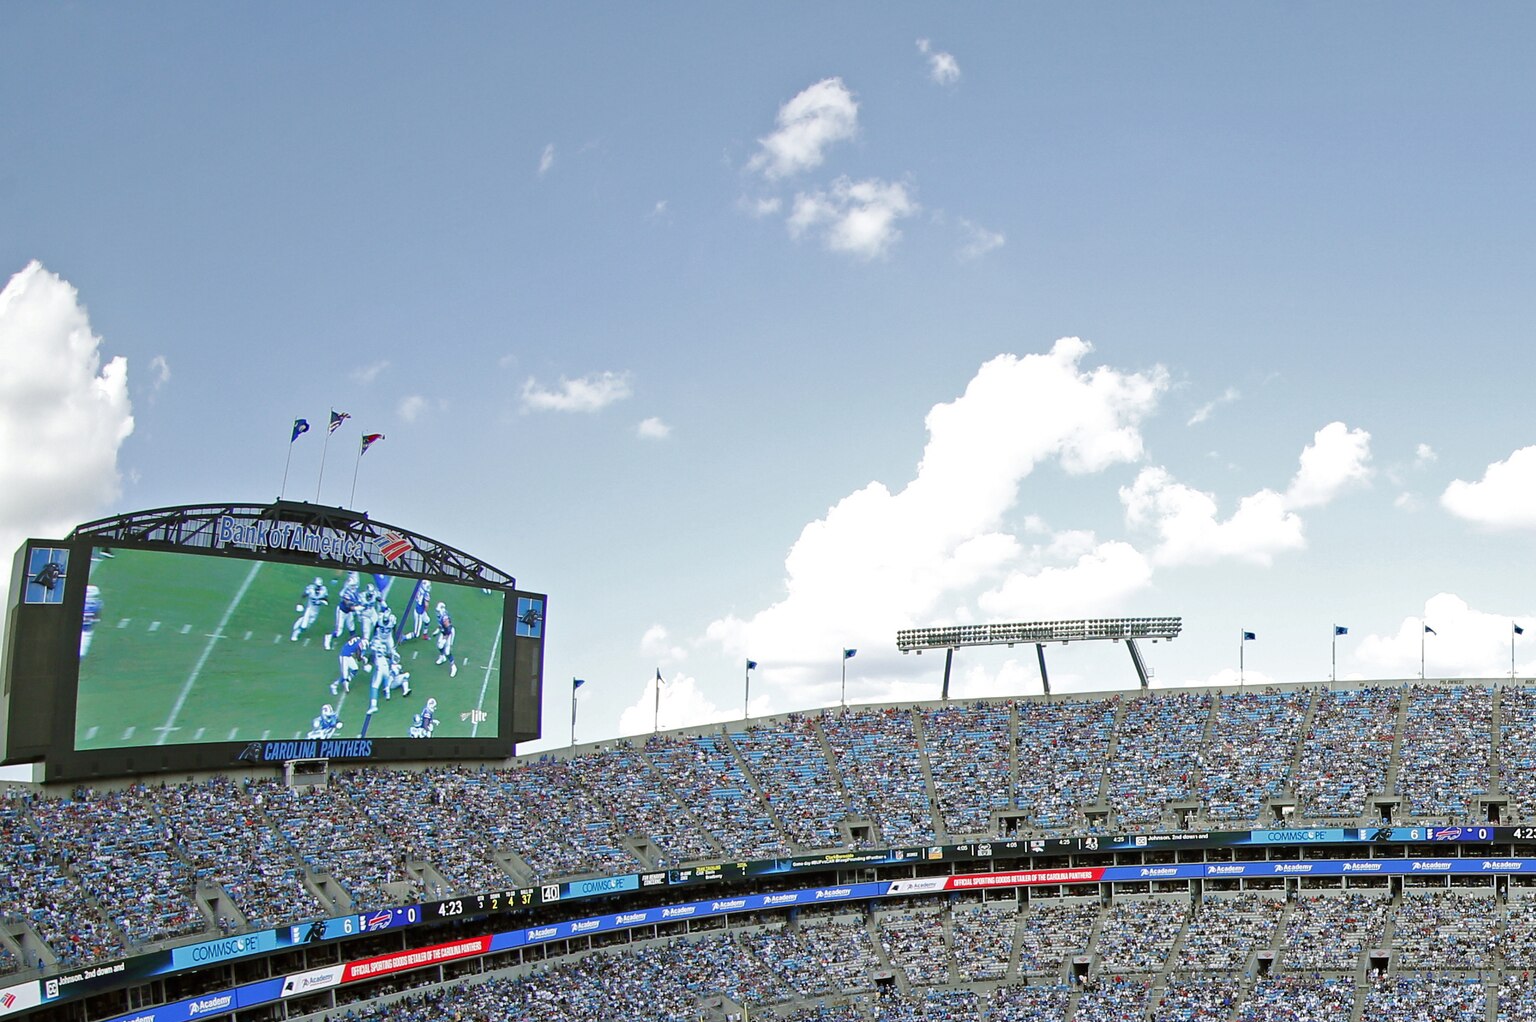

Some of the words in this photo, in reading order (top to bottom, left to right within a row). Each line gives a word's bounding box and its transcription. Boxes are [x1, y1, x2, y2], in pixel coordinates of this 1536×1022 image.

[219, 516, 267, 547] Bank
[269, 525, 291, 549] of
[291, 526, 364, 559] America
[471, 709, 487, 725] Lite
[264, 741, 317, 761] CAROLINA
[320, 740, 373, 759] PANTHERS
[1268, 831, 1325, 841] COMMSCOPE
[1410, 829, 1418, 839] 6
[1478, 828, 1486, 839] 0
[1217, 865, 1245, 873] Academy
[1284, 864, 1312, 872] Academy
[1422, 862, 1451, 870] Academy
[1492, 862, 1522, 870] Academy
[954, 878, 972, 886] OFFICIAL
[973, 876, 995, 886] SPORTING
[1012, 874, 1032, 883] RETAILER
[1047, 872, 1068, 880] CAROLINA
[1069, 871, 1092, 879] PANTHERS
[582, 878, 624, 893] COMMSCOPE
[544, 886, 558, 900] 40
[824, 888, 850, 897] Academy
[508, 896, 514, 906] 4
[522, 894, 532, 904] 37
[438, 900, 463, 917] 4:23
[492, 900, 498, 910] 2
[720, 900, 746, 910] Academy
[407, 908, 416, 922] 0
[343, 919, 352, 934] 6
[192, 936, 257, 962] COMMSCOPE
[114, 962, 125, 972] and
[199, 995, 232, 1010] Academy
